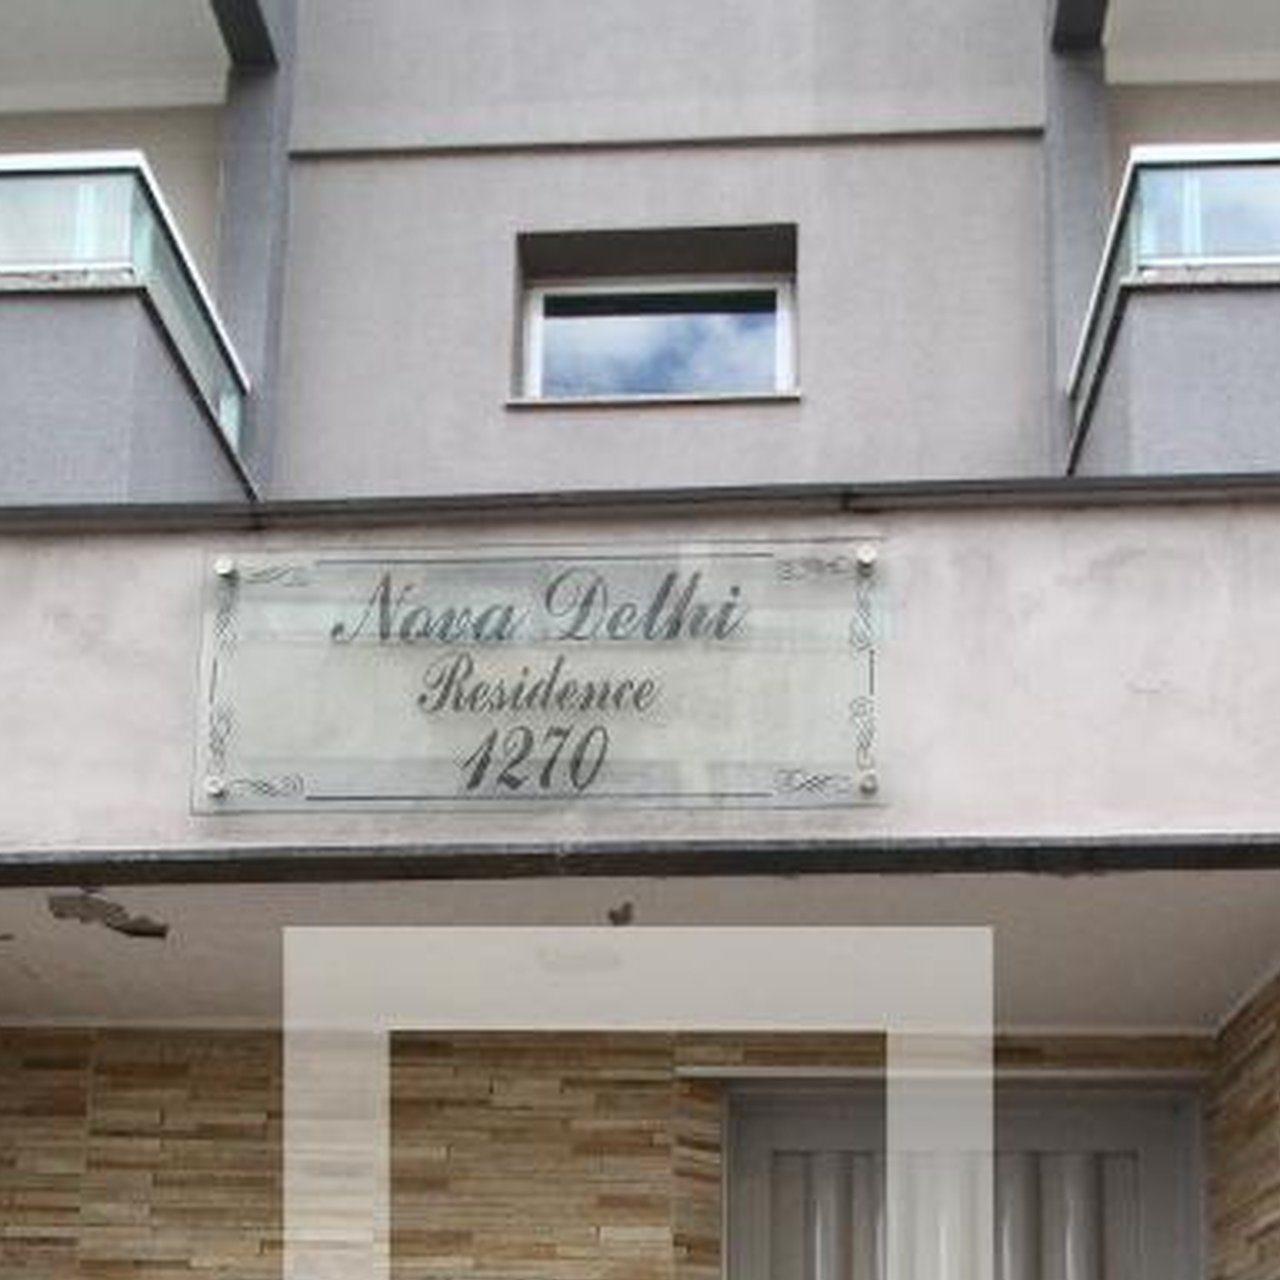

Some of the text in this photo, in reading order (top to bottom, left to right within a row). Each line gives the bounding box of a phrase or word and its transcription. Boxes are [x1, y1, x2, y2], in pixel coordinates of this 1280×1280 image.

[331, 567, 746, 644] Nova Delhi
[418, 652, 658, 713] Residence
[458, 724, 609, 791] 1270
